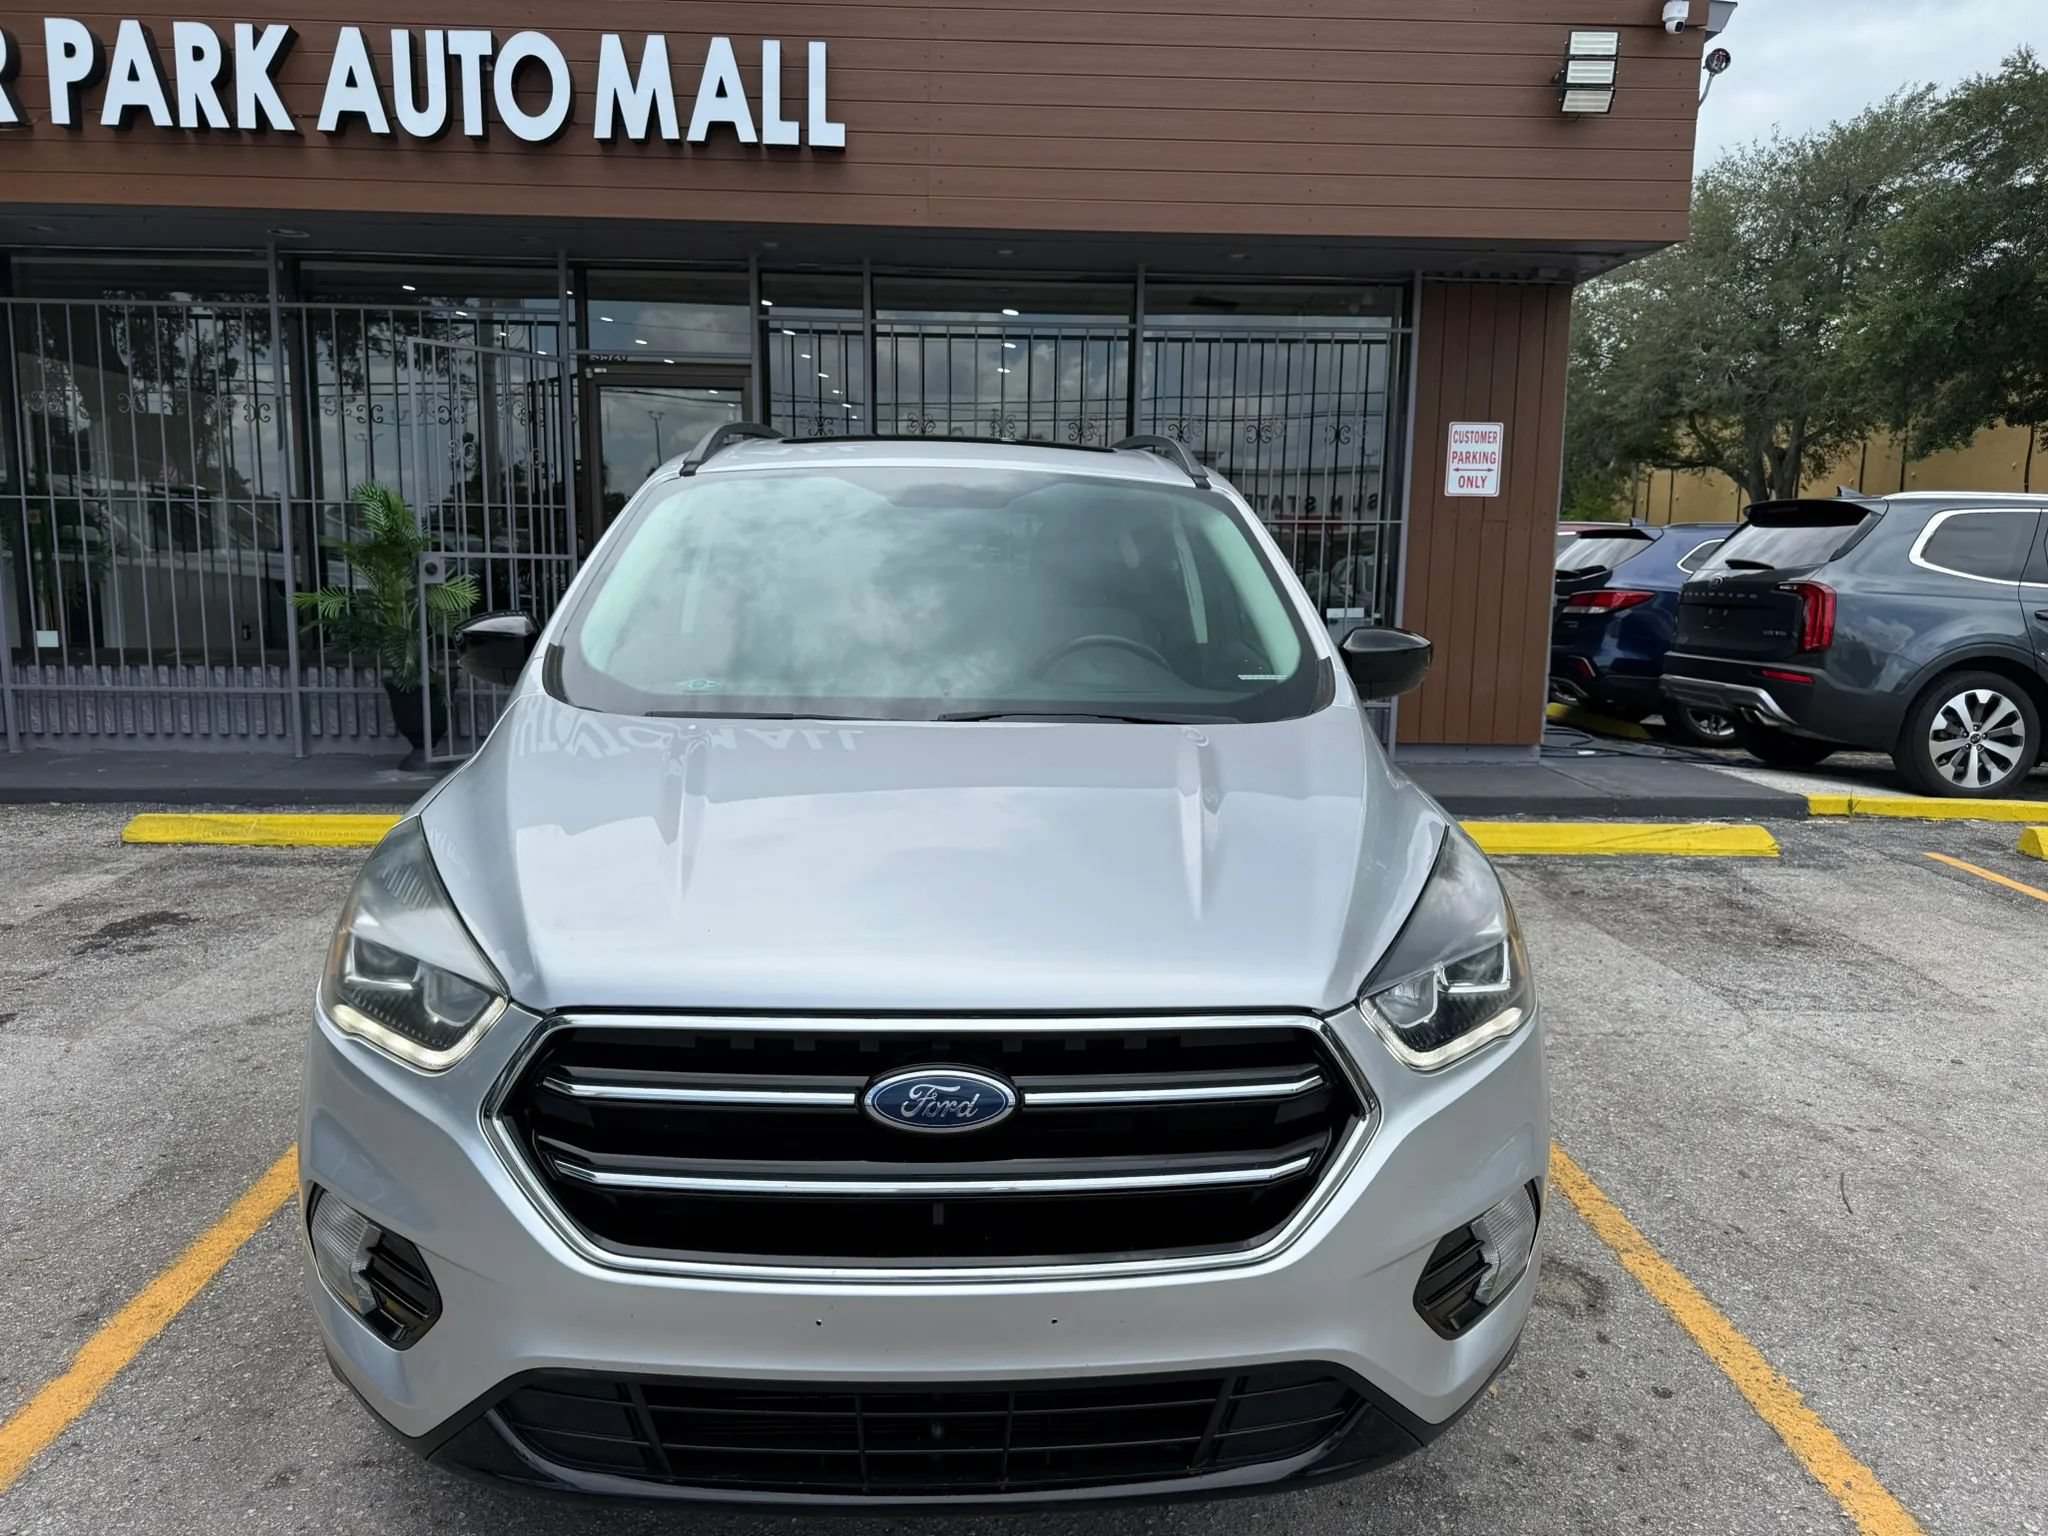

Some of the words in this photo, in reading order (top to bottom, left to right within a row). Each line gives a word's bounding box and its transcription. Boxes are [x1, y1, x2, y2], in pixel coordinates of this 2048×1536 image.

[44, 17, 295, 132] PARK
[318, 26, 572, 143] AUTO
[593, 33, 846, 148] MALL
[1453, 430, 1498, 444] CUSTOMER
[1452, 451, 1496, 464] PARKING
[1458, 475, 1488, 488] ONLY
[900, 1083, 980, 1118] Ford
